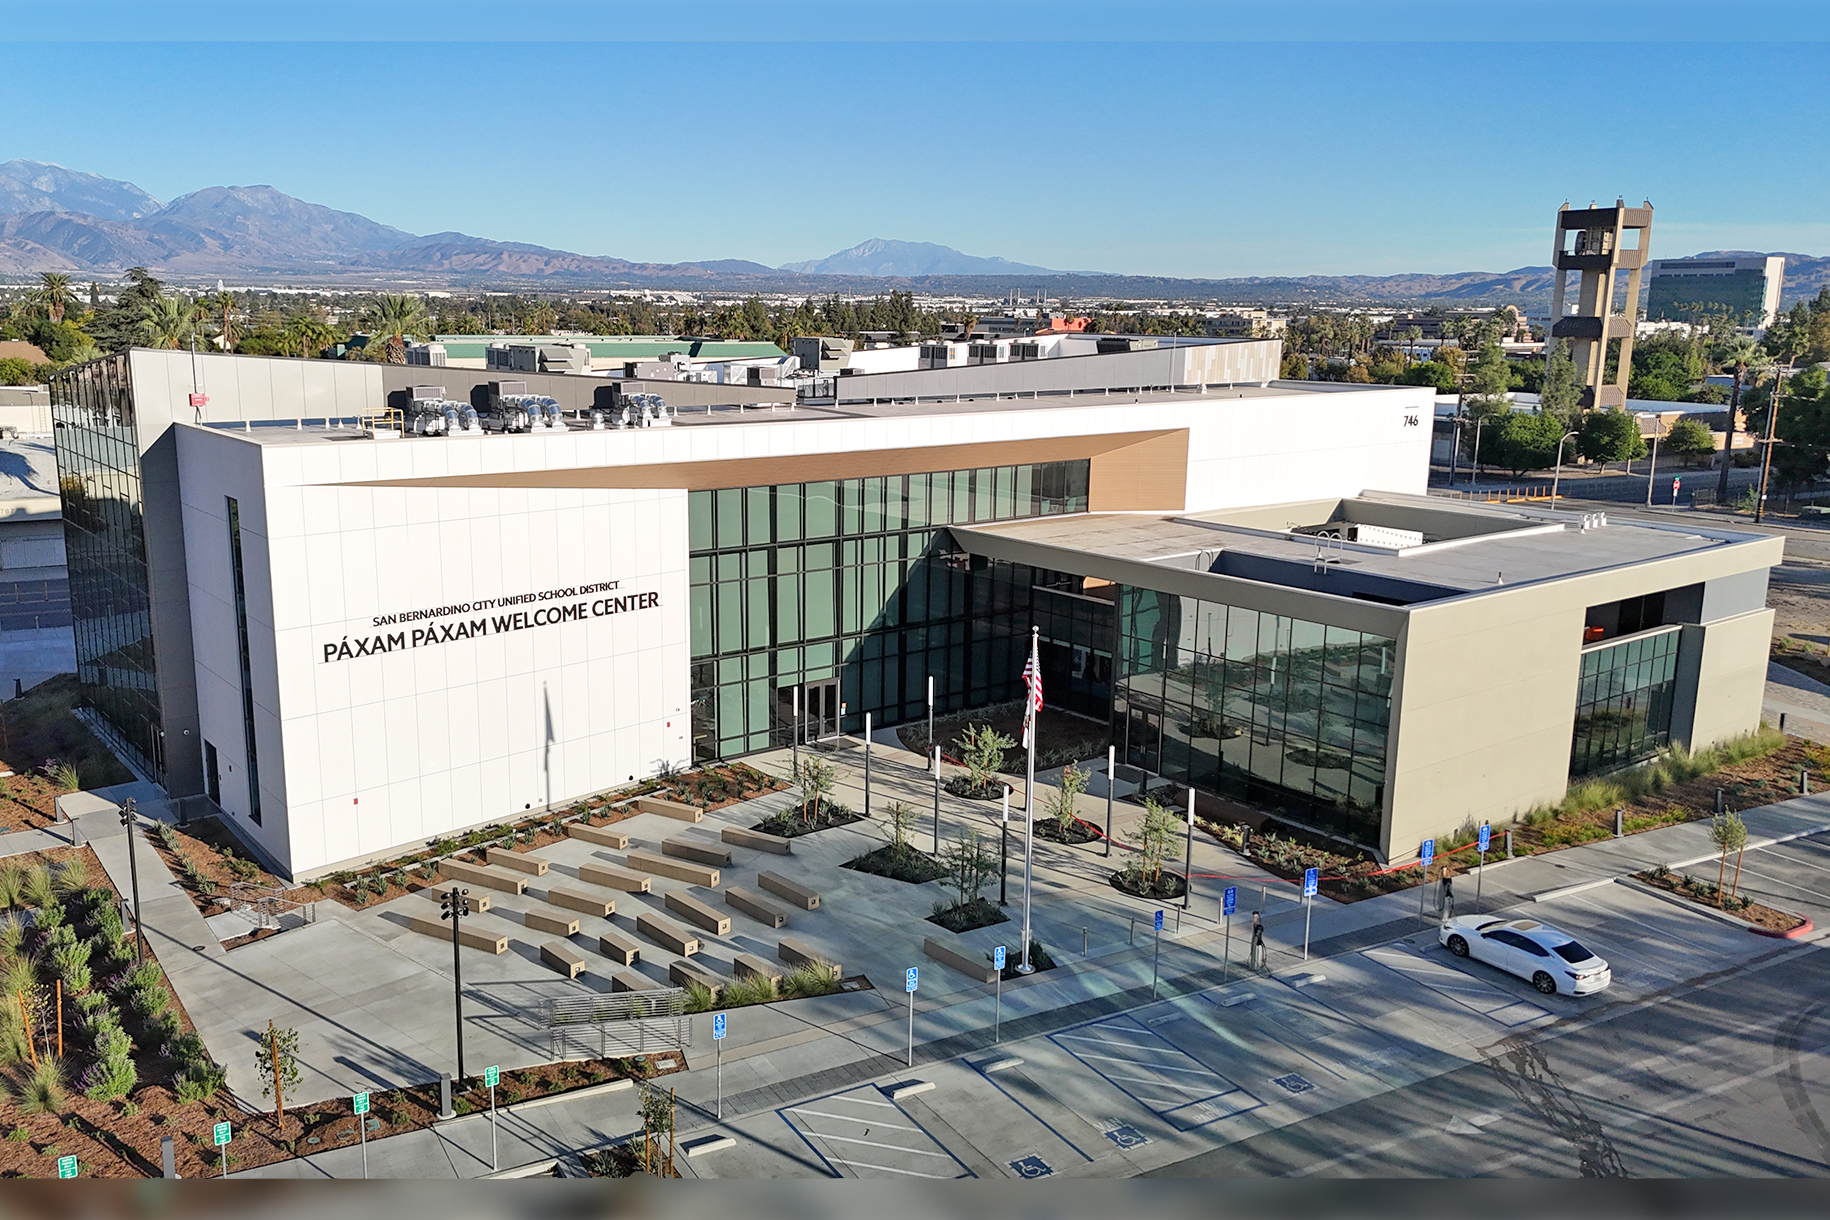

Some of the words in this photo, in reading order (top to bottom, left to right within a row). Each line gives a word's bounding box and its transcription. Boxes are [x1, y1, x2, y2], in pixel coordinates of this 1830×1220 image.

[1403, 415, 1418, 427] 746
[372, 614, 397, 627] SAN
[399, 603, 471, 623] BERNARDINO
[472, 599, 496, 611] CITY
[497, 593, 537, 607] UNIFIED
[538, 587, 578, 601] SCHOOL
[579, 580, 620, 595] DISTRICT
[323, 631, 405, 663] PÁXAM
[411, 617, 487, 648] PÁXAM
[491, 602, 588, 634] WELCOME
[591, 591, 659, 617] CENTER
[1093, 1117, 1124, 1130] VAN
